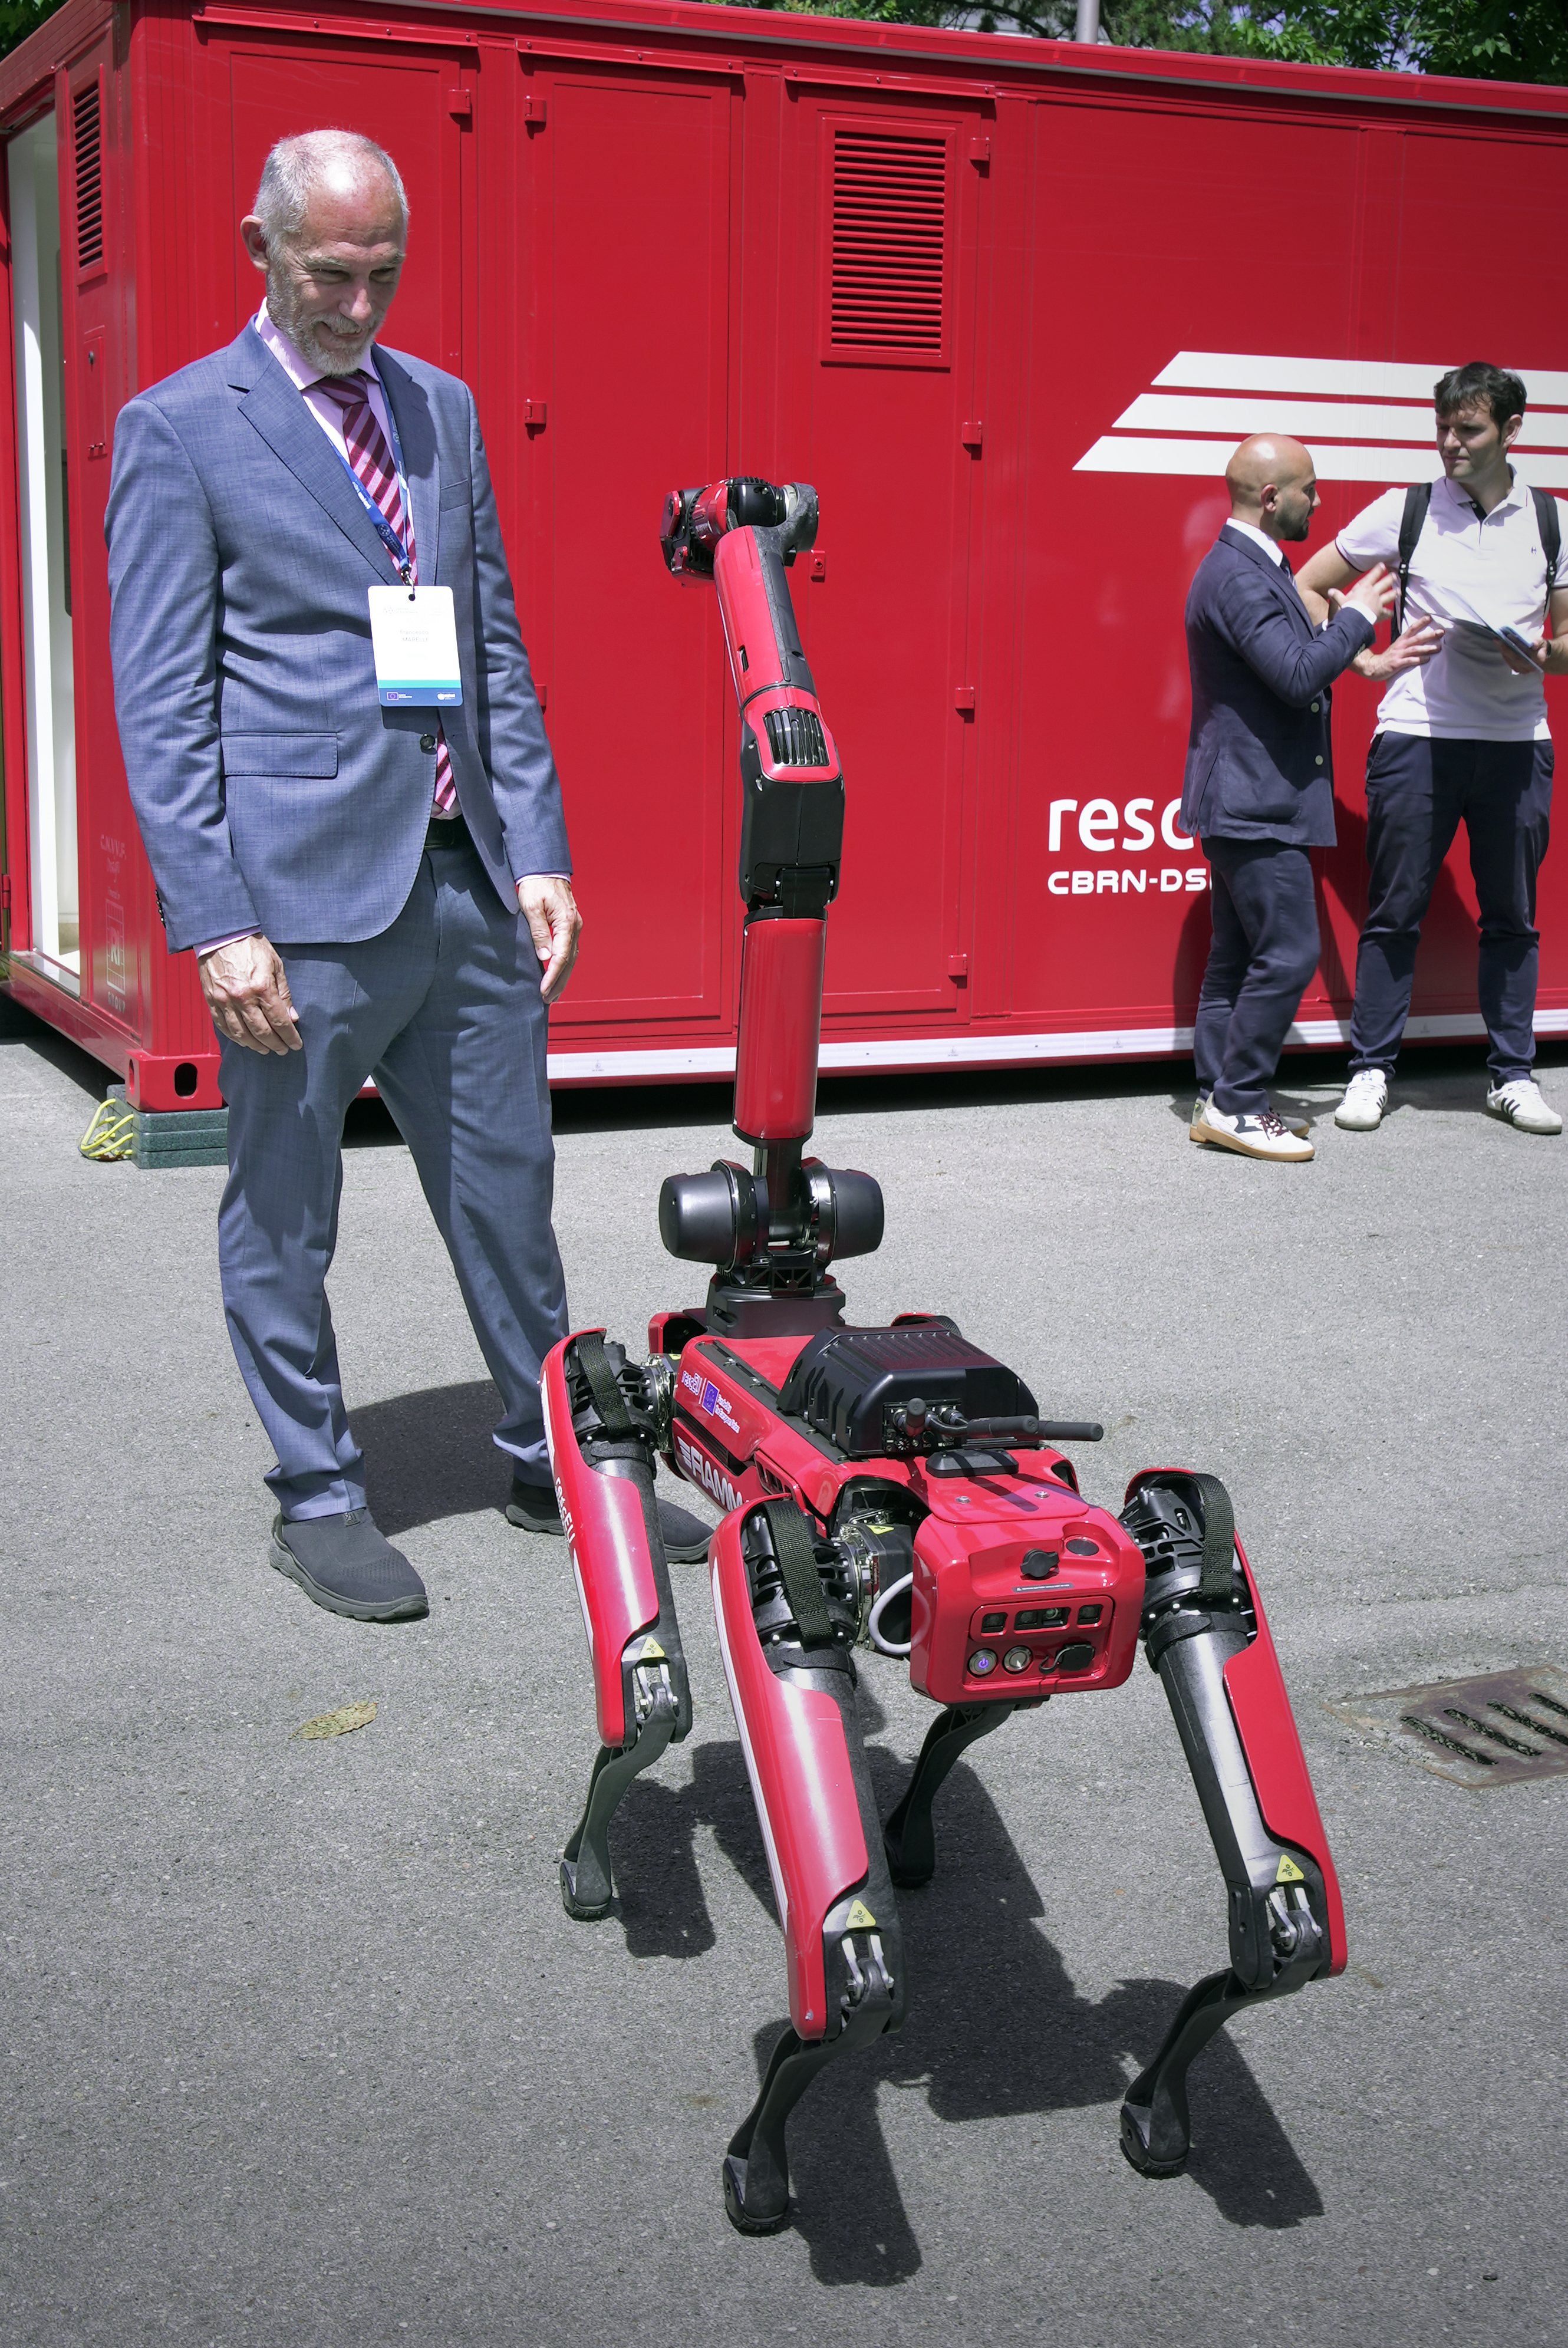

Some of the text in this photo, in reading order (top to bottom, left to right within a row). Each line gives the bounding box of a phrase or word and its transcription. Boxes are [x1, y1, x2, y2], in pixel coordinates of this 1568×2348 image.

[1047, 868, 1213, 895] CBRN-DS
[681, 1371, 703, 1396] rescEU
[690, 1445, 749, 1511] FIAMM
